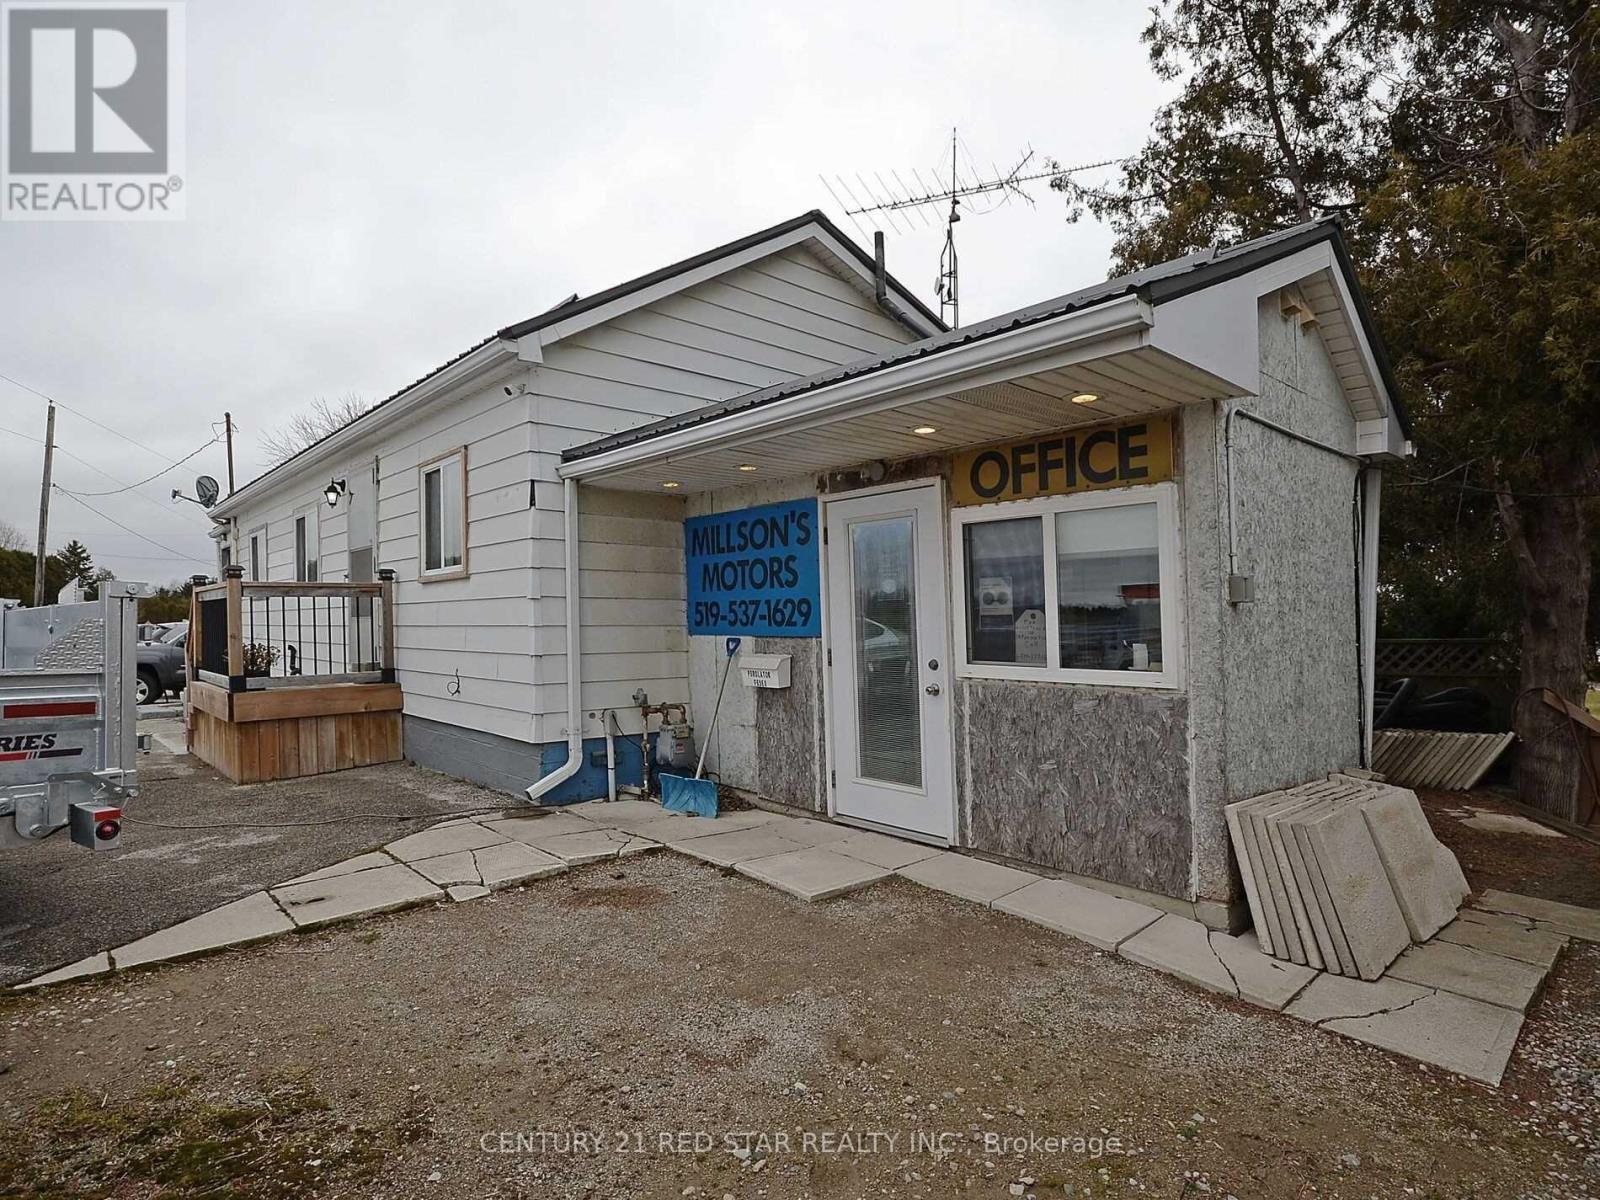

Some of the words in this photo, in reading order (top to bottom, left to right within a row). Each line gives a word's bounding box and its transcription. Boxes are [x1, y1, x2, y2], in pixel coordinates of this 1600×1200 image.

[970, 424, 1149, 498] OFFICE
[692, 510, 811, 557] MILLSON'S
[702, 554, 799, 592] MOTORS
[694, 598, 812, 627] 519-537-1629
